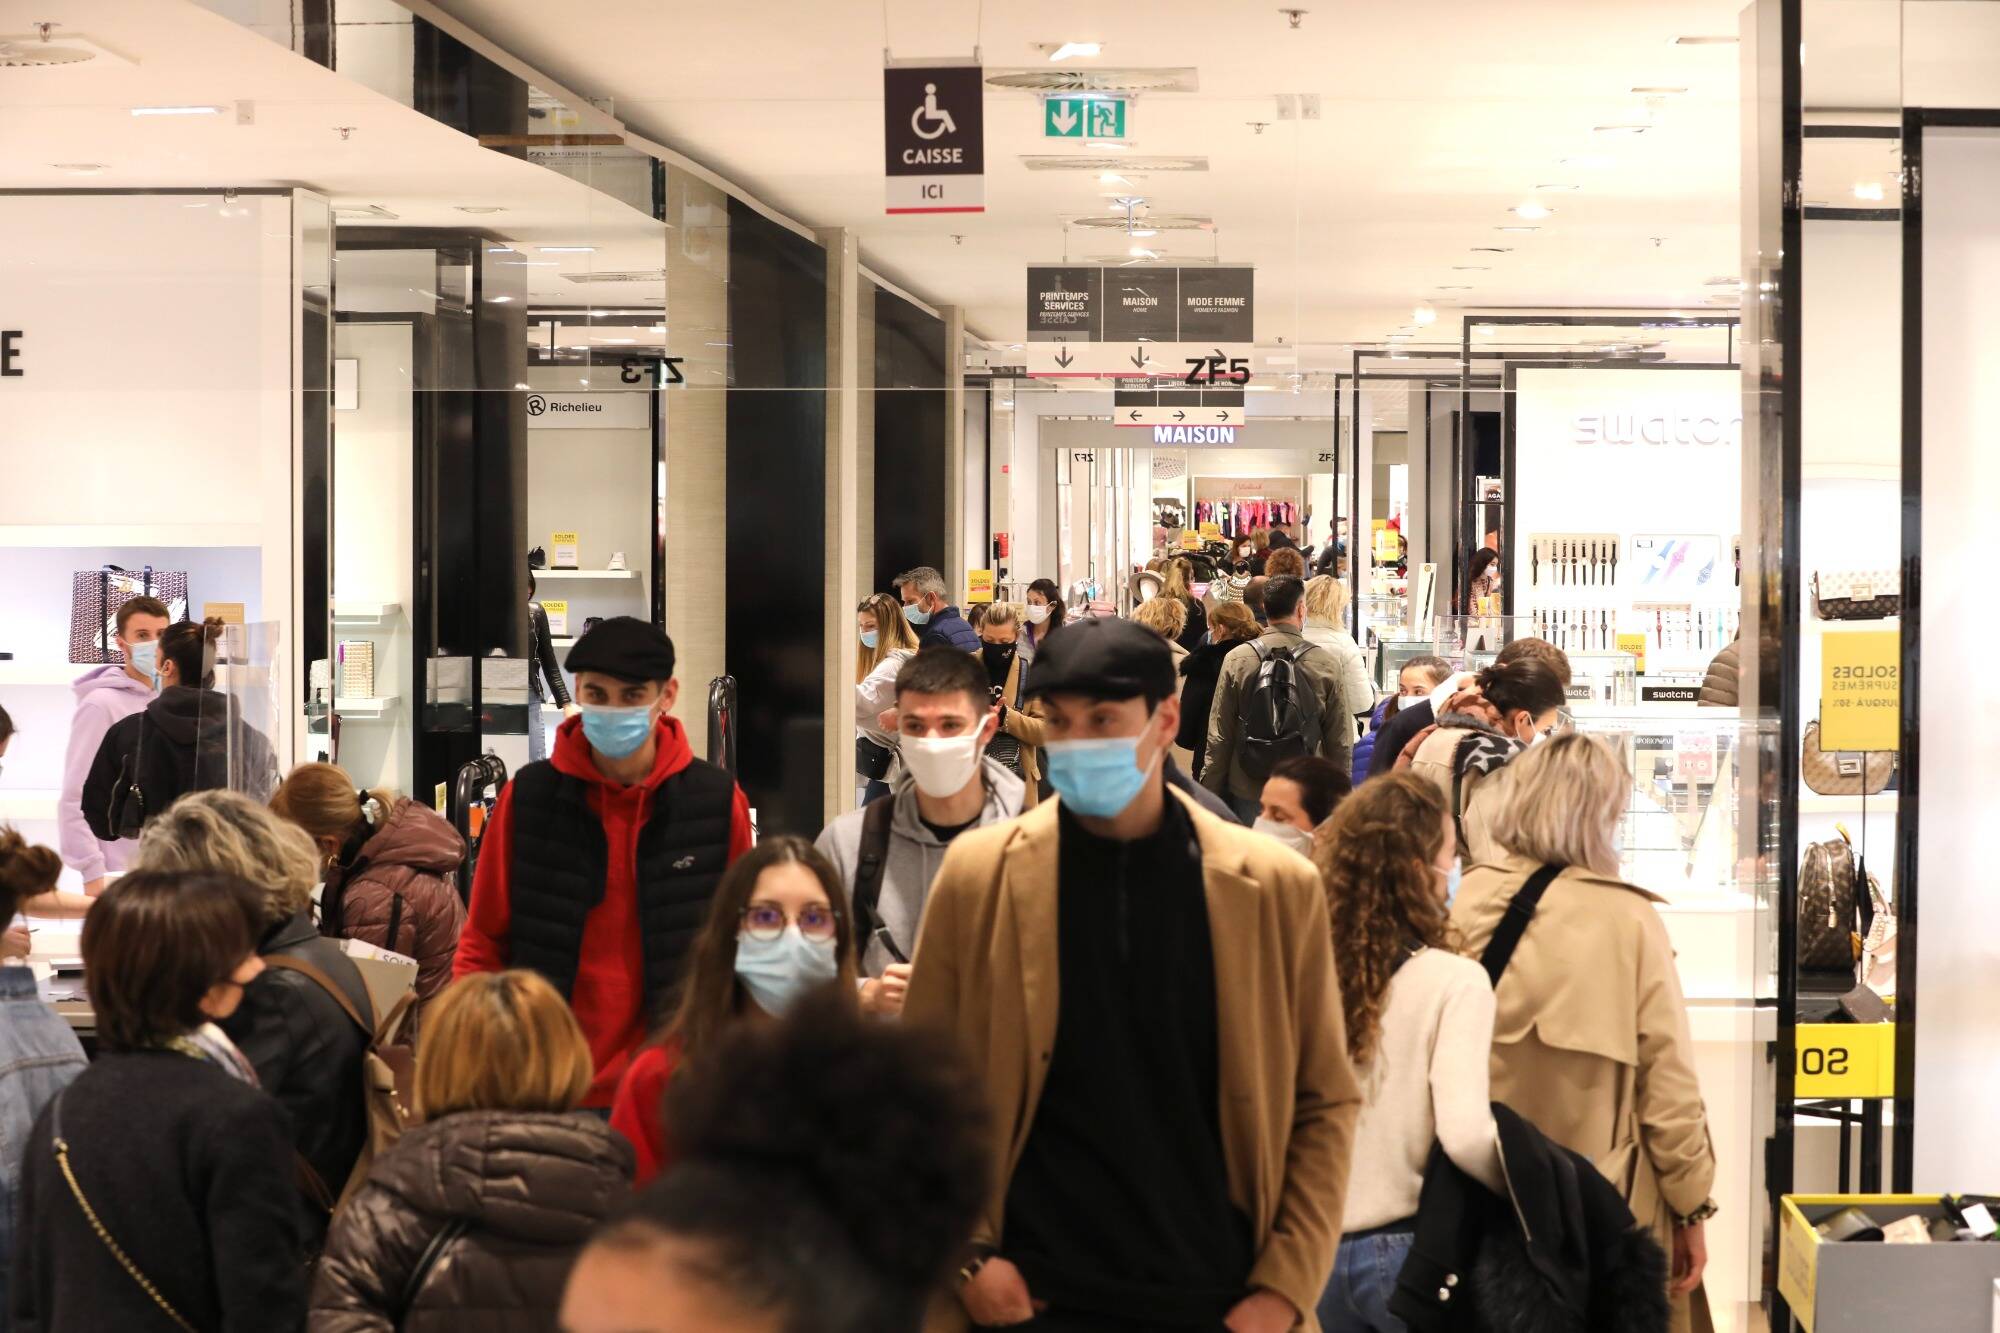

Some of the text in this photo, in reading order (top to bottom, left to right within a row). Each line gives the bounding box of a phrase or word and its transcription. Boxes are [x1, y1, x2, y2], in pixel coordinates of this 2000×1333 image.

[902, 148, 963, 164] CAISSE
[922, 184, 943, 199] ICI
[1040, 292, 1089, 301] PRINTEMPS
[1044, 302, 1085, 310] SERVICES
[1123, 297, 1158, 306] MAISON
[1187, 297, 1246, 306] MODE FEMME
[1185, 358, 1250, 385] ZF5
[550, 402, 602, 412] Richelieu
[1154, 425, 1234, 443] MAISON
[1652, 690, 1688, 699] swatch
